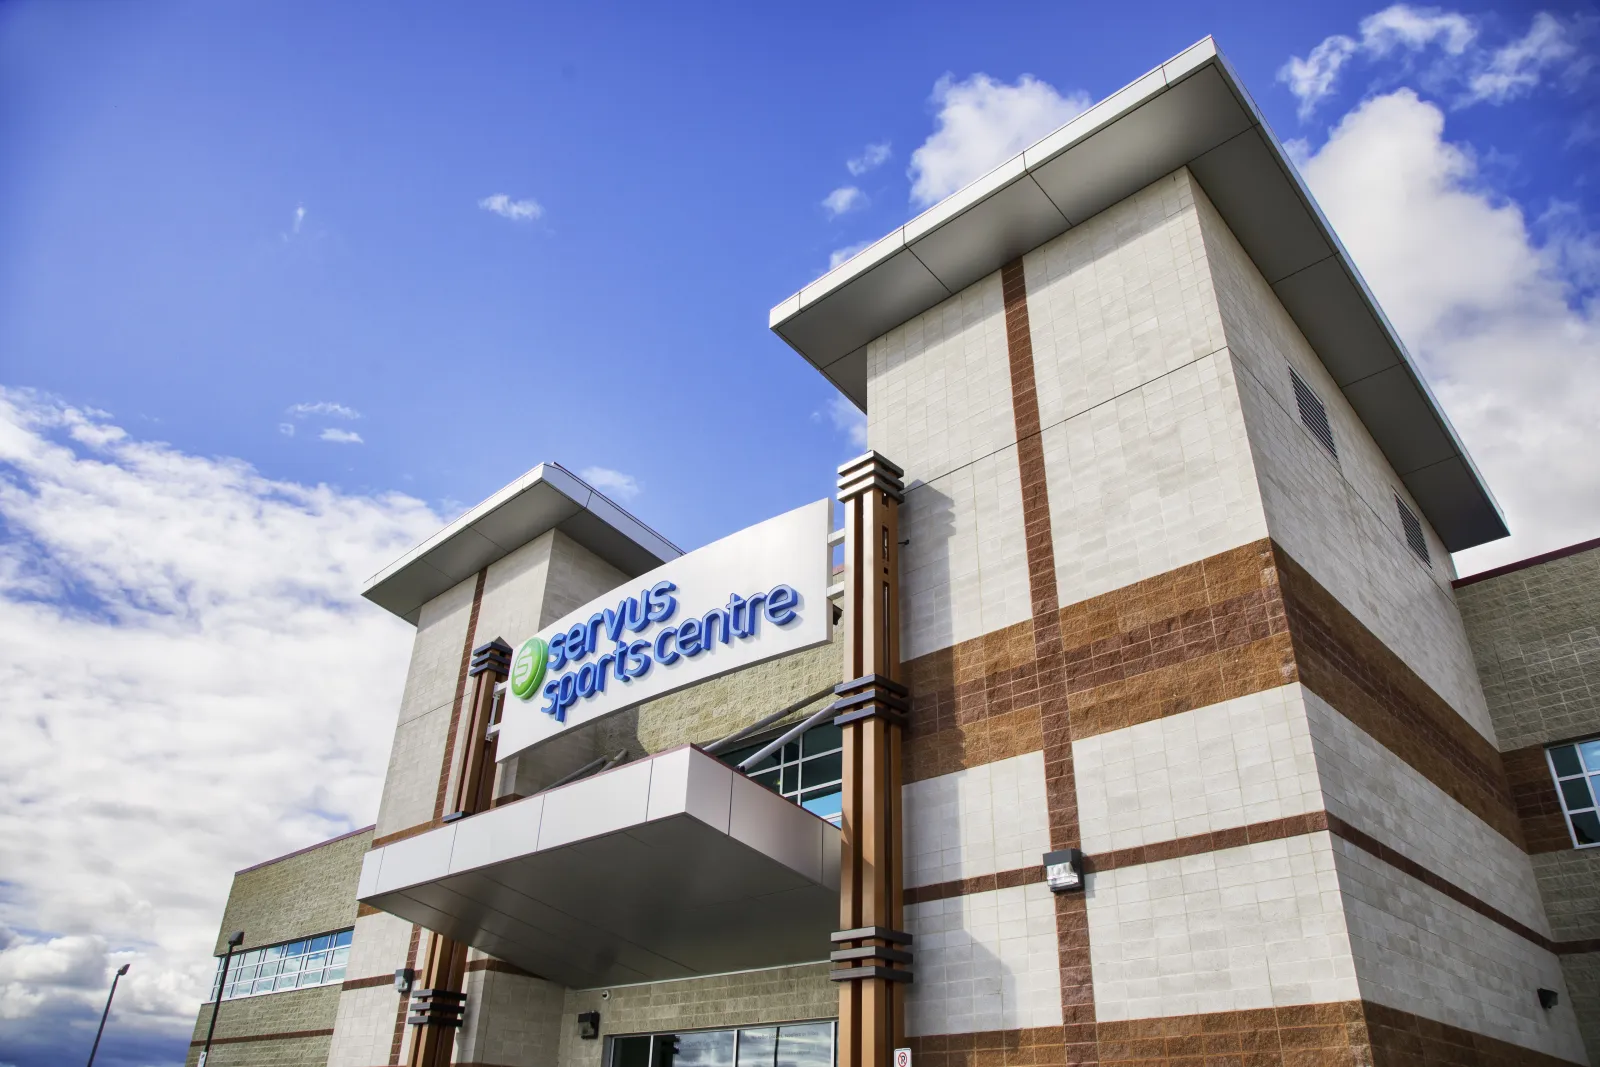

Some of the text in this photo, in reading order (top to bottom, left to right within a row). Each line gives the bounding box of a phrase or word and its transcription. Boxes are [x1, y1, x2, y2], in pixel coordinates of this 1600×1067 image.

[541, 583, 798, 722] sports centre
[548, 580, 676, 671] servus
